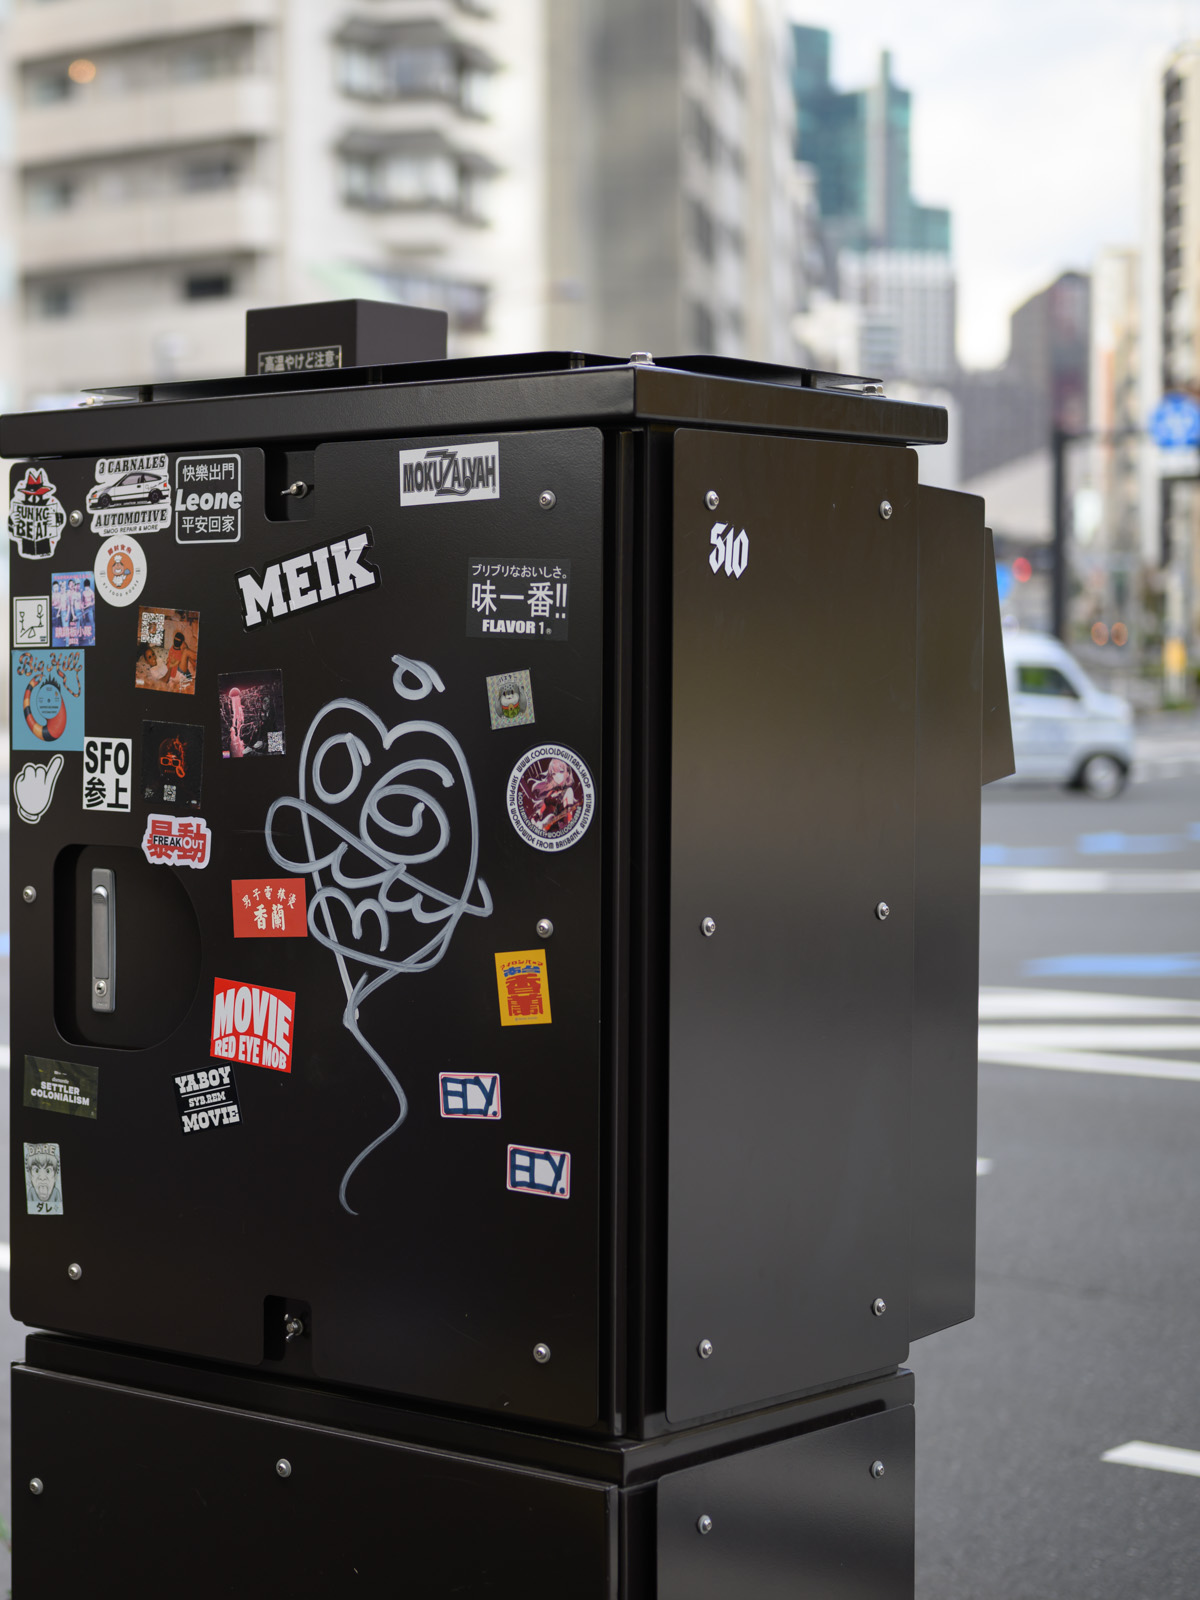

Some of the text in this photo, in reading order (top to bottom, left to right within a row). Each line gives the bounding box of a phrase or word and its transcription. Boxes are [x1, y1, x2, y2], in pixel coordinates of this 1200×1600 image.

[98, 455, 166, 474] 3 CARNALES
[182, 462, 235, 482] 快樂出門
[175, 488, 243, 512] Leone
[95, 509, 167, 527] AUTOMOTIVE
[181, 515, 235, 534] 平安回家
[237, 532, 376, 627] MEIK
[482, 619, 536, 634] FLAVOR
[17, 652, 45, 677] Big
[85, 740, 130, 776] SFO
[84, 776, 129, 809] 参上
[510, 807, 536, 843] WORLDWIDE
[535, 839, 555, 849] FROM
[579, 793, 592, 830] AUSTRALIA
[153, 835, 204, 849] FREAK OUT
[253, 903, 286, 931] 香蘭
[213, 985, 292, 1056] MOVIE
[214, 1035, 287, 1070] RED EYE MOB
[41, 1081, 80, 1095] SETTLER
[175, 1065, 232, 1093] YABOY
[30, 1088, 90, 1106] COLONIALISM
[181, 1104, 240, 1133] MOVIE
[28, 1144, 56, 1156] DARE
